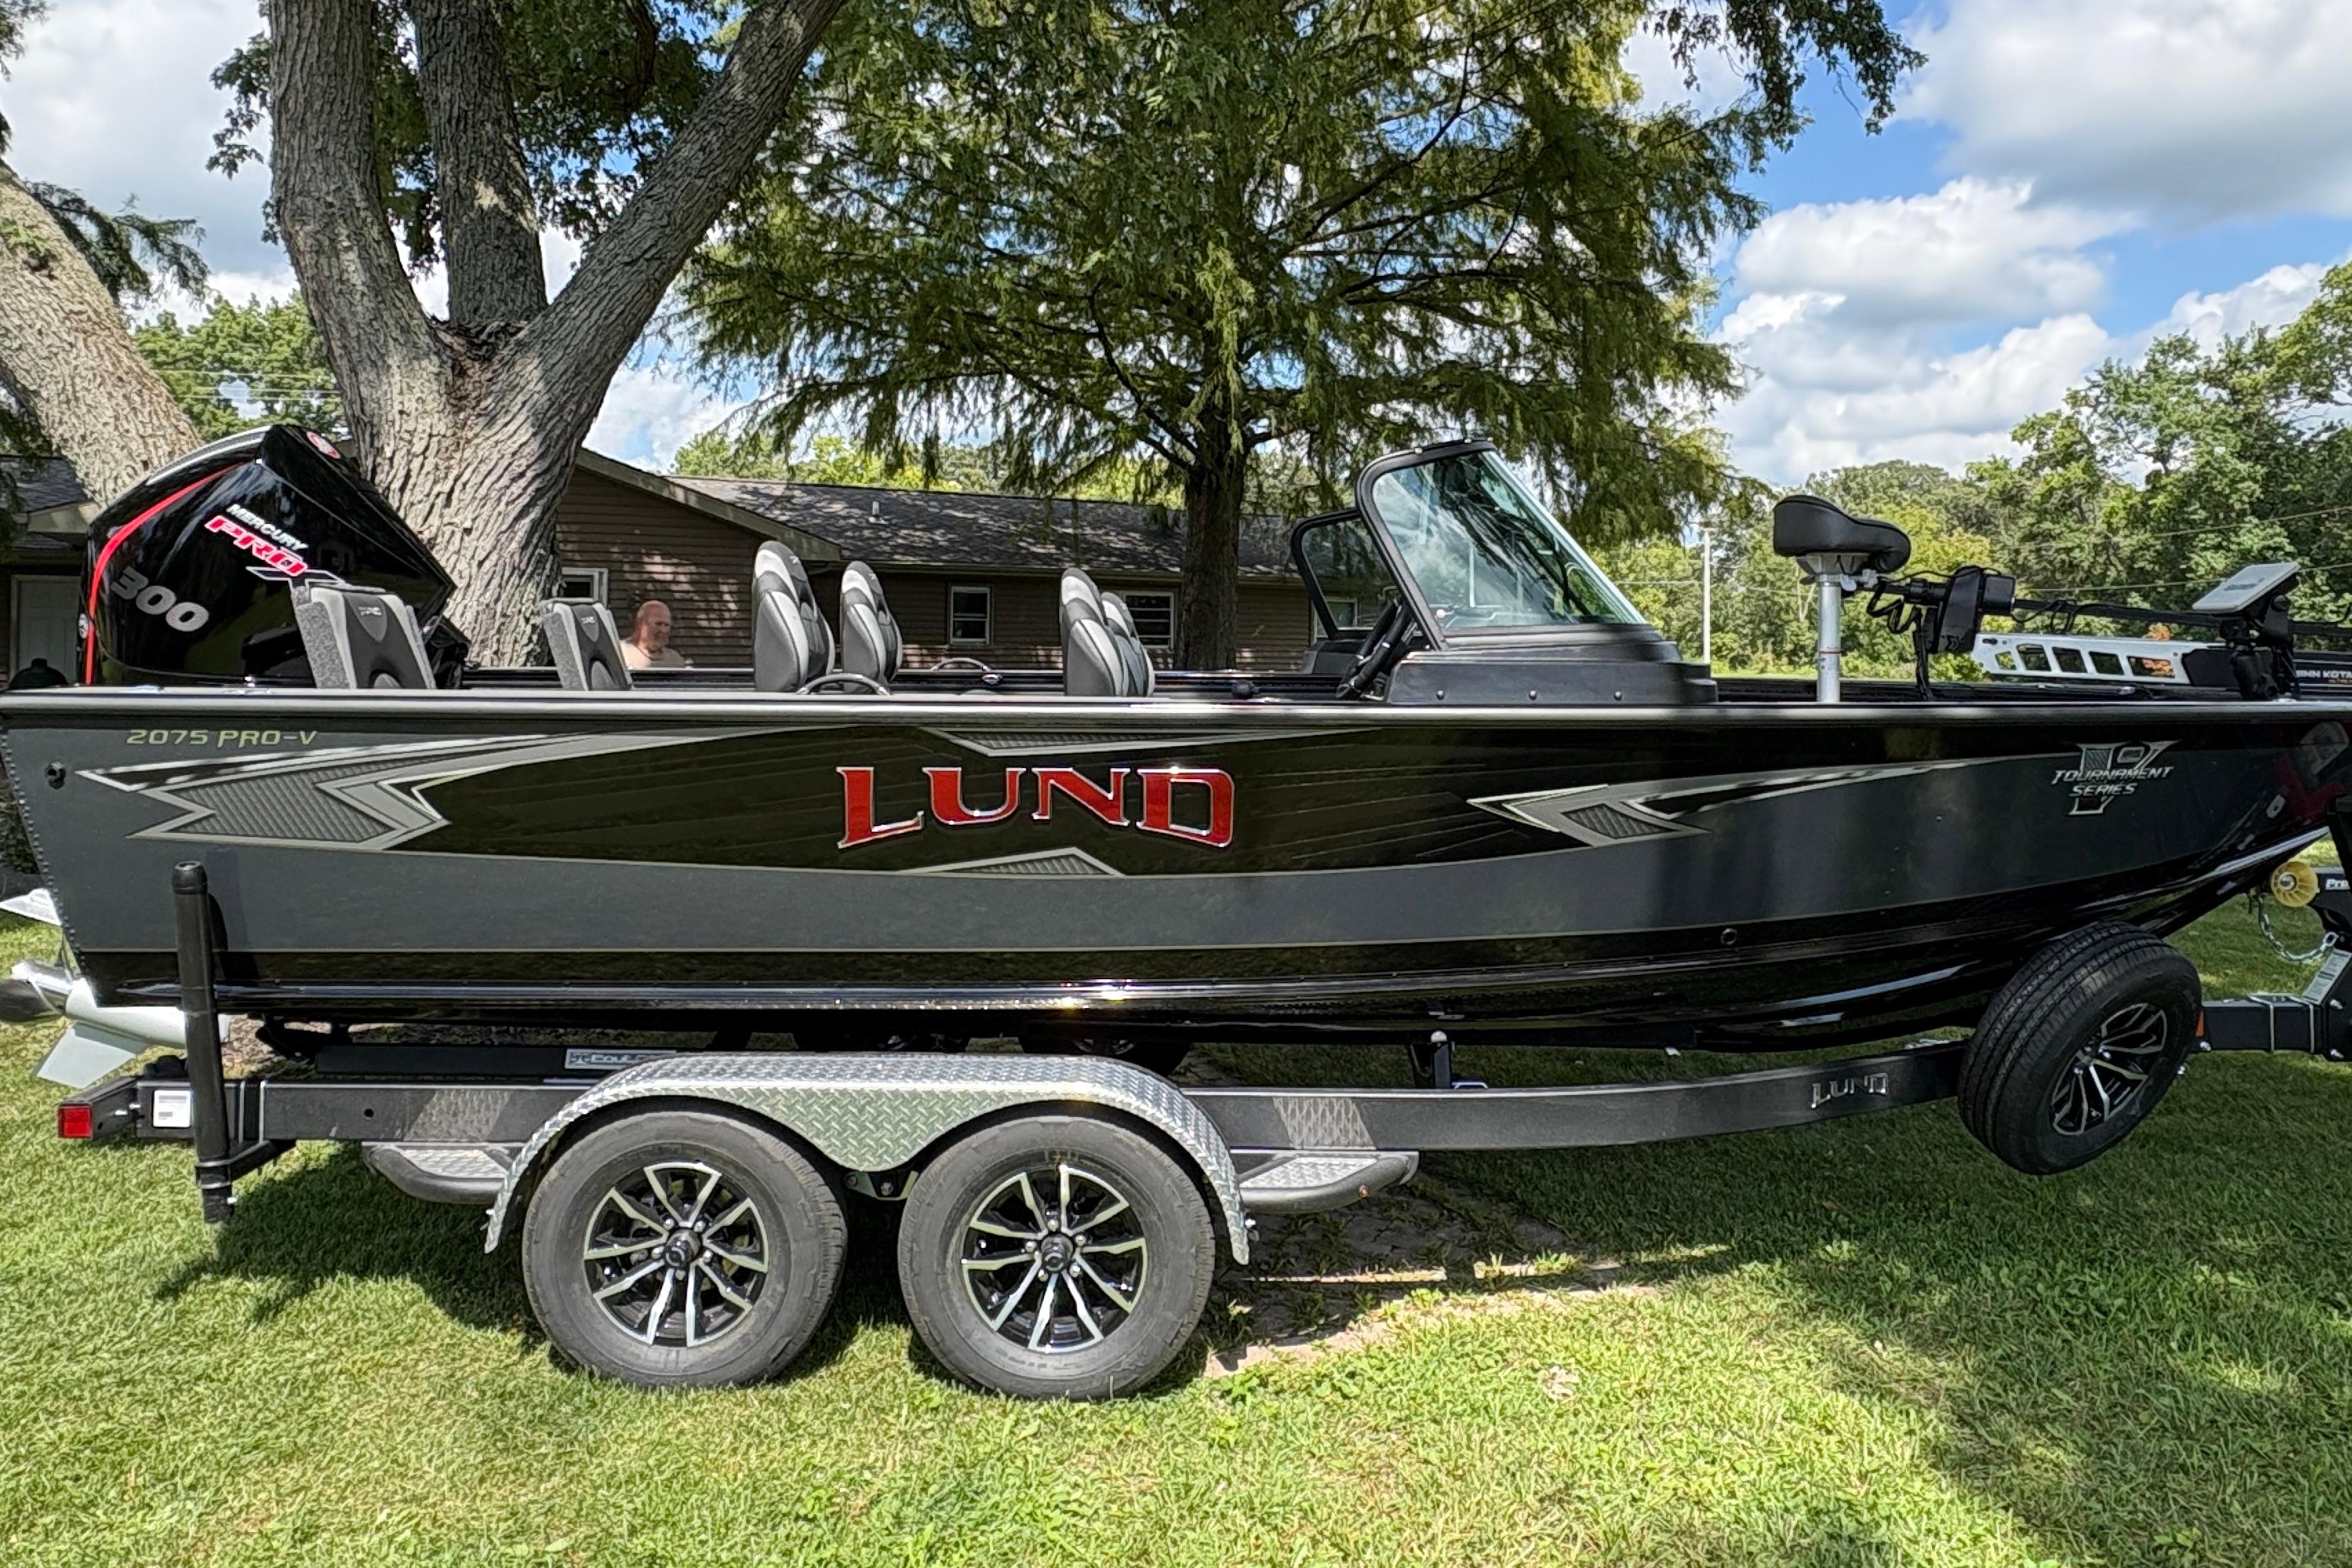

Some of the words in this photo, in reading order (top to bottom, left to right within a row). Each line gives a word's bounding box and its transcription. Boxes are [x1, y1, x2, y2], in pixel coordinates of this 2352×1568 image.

[205, 515, 308, 577] PRO
[225, 504, 308, 550] MERCURY
[110, 566, 210, 632] 300
[126, 729, 210, 745] 2075
[217, 730, 318, 749] PRO-V
[2051, 766, 2173, 785] TOURNAMENT
[2069, 783, 2138, 796] SERIES
[836, 766, 1235, 849] LUND
[1811, 1072, 1889, 1109] LUND
